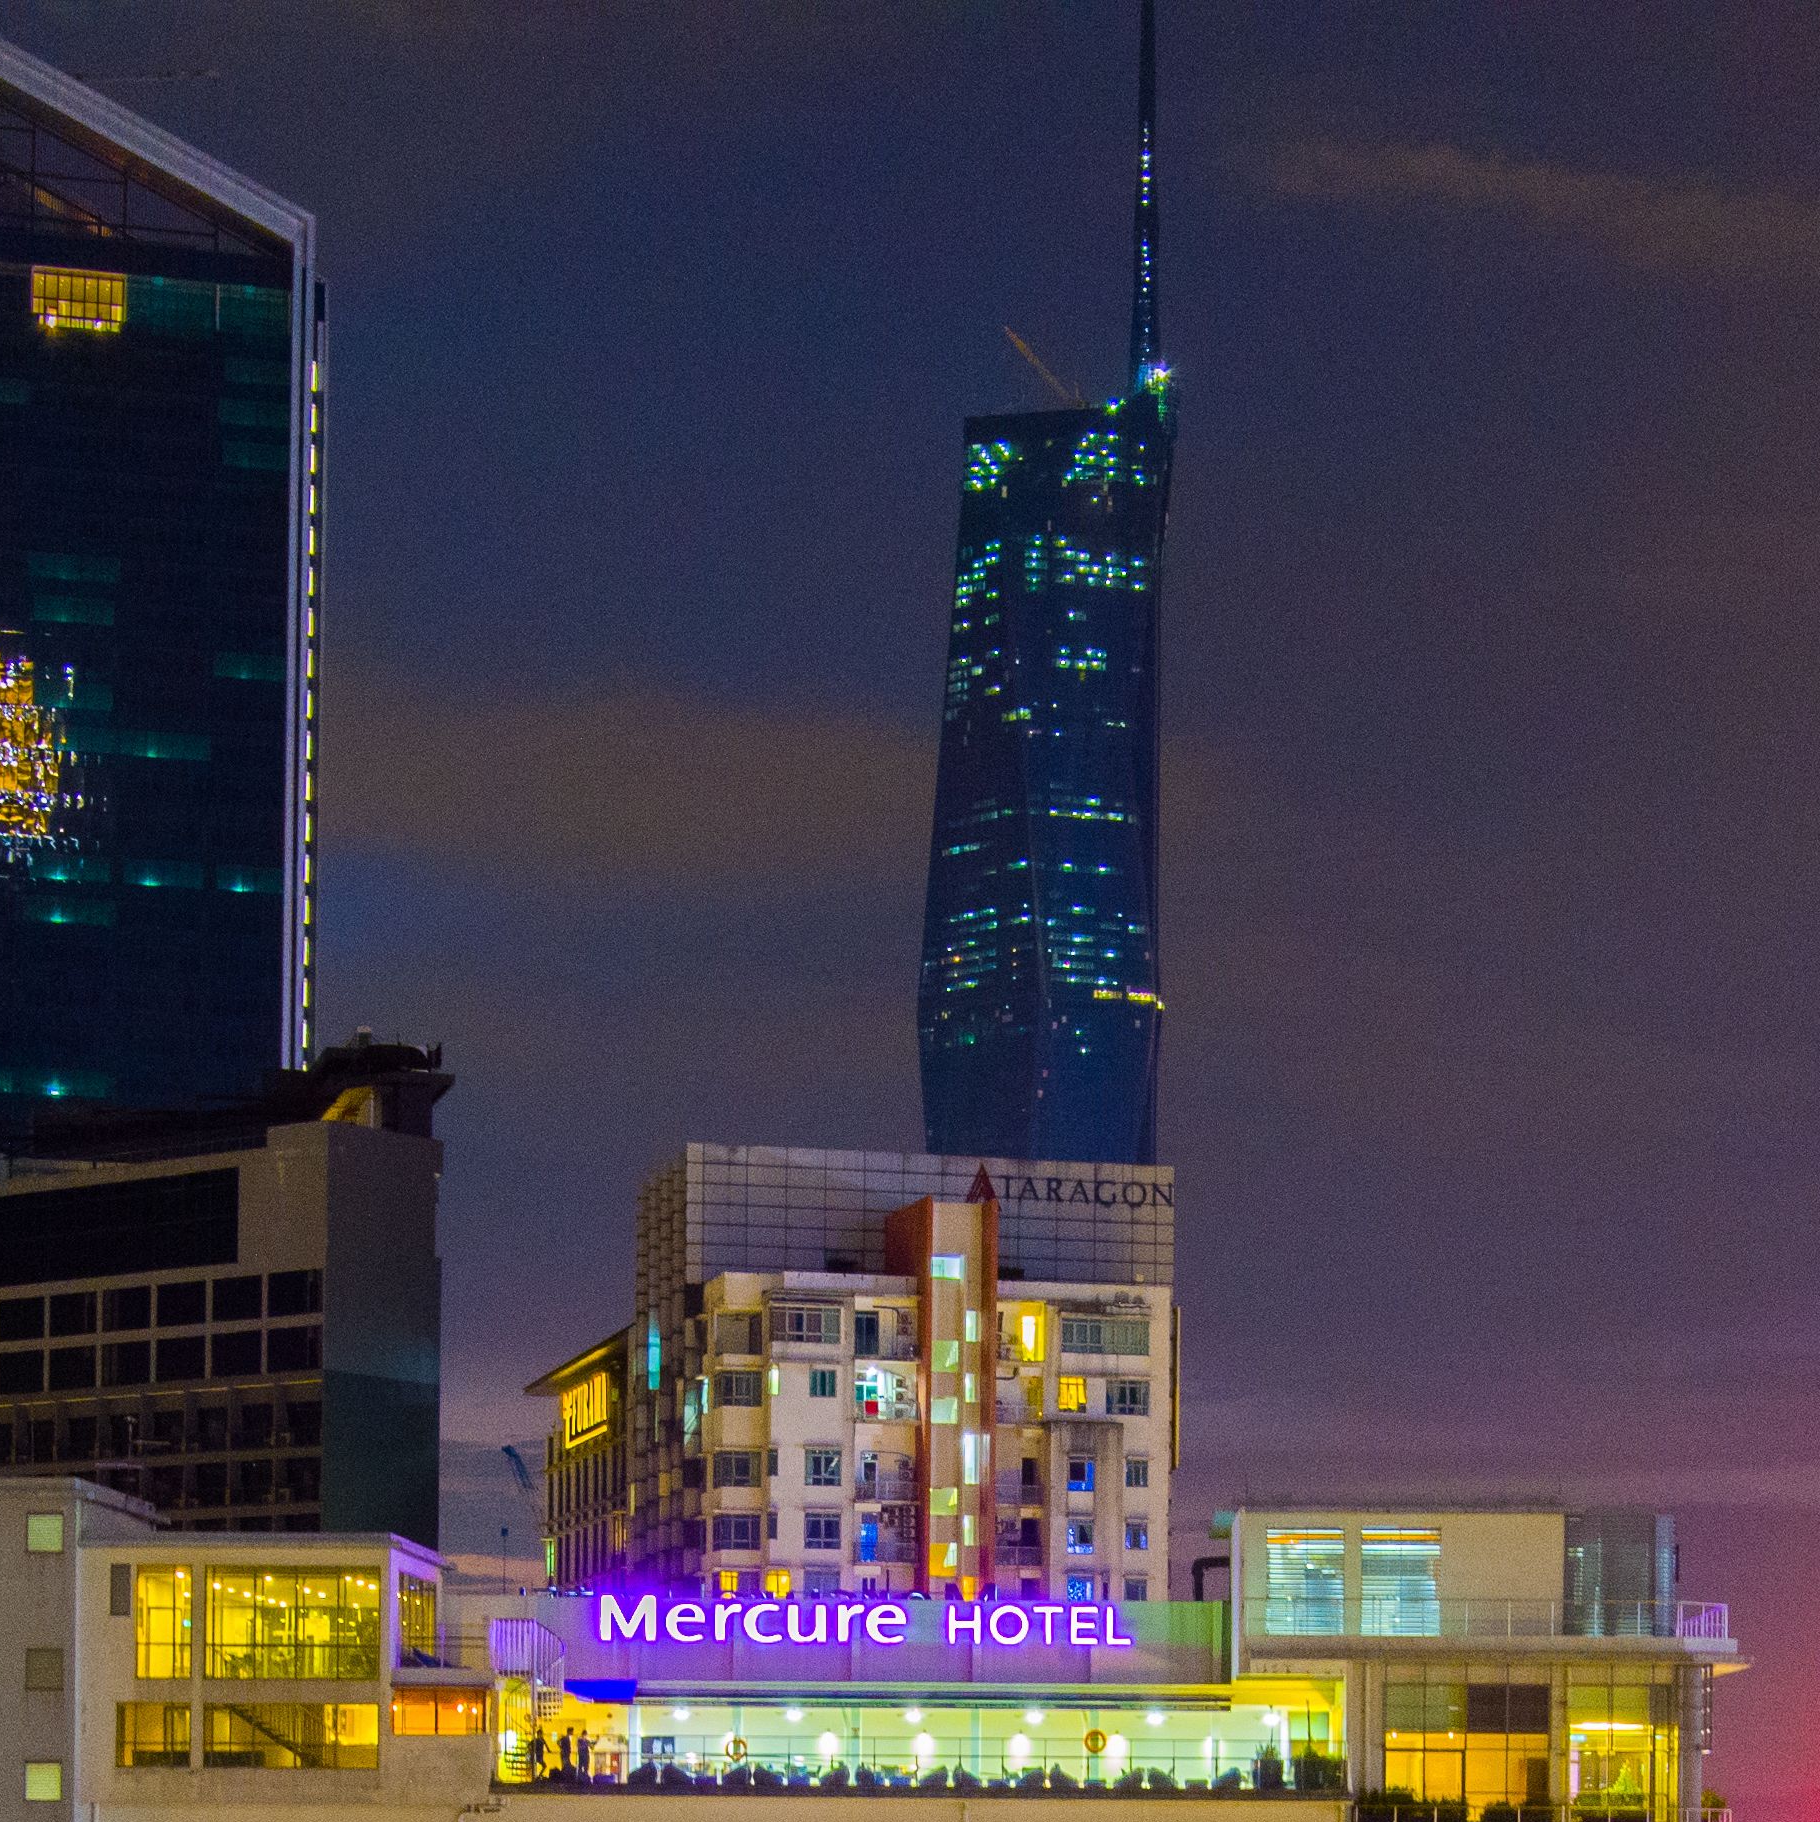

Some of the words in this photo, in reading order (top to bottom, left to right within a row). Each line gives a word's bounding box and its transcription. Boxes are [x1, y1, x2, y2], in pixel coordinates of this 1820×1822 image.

[998, 1175, 1175, 1208] TARAGON
[598, 1594, 908, 1644] Mercure
[947, 1604, 1133, 1646] HOTEL
